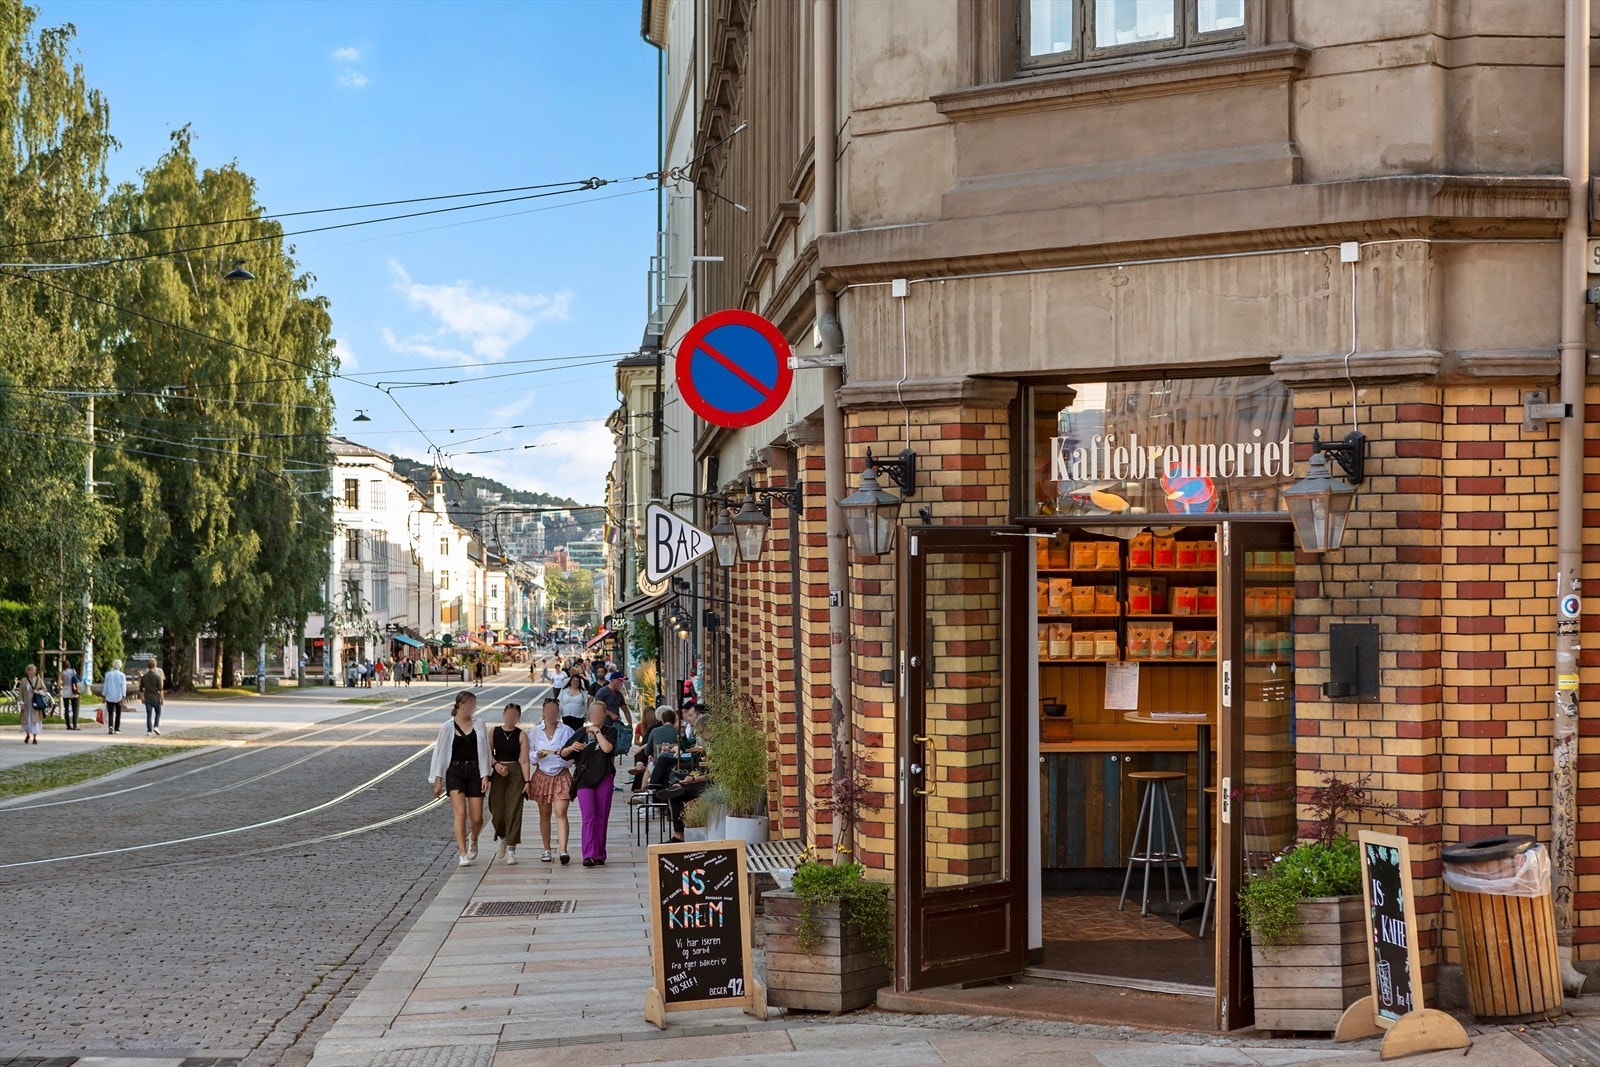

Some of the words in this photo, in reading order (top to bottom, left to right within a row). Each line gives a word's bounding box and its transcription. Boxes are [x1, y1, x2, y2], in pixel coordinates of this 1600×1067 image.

[1049, 428, 1294, 482] Kaffebrenneriet
[656, 513, 701, 573] BAR
[668, 901, 723, 929] KREM
[676, 938, 683, 949] Vi
[687, 938, 700, 948] har
[682, 949, 690, 960] og
[684, 960, 697, 971] eget
[699, 957, 720, 967] bakeri
[667, 971, 688, 985] TREAT
[669, 985, 680, 995] YO
[709, 986, 728, 996] BEGER
